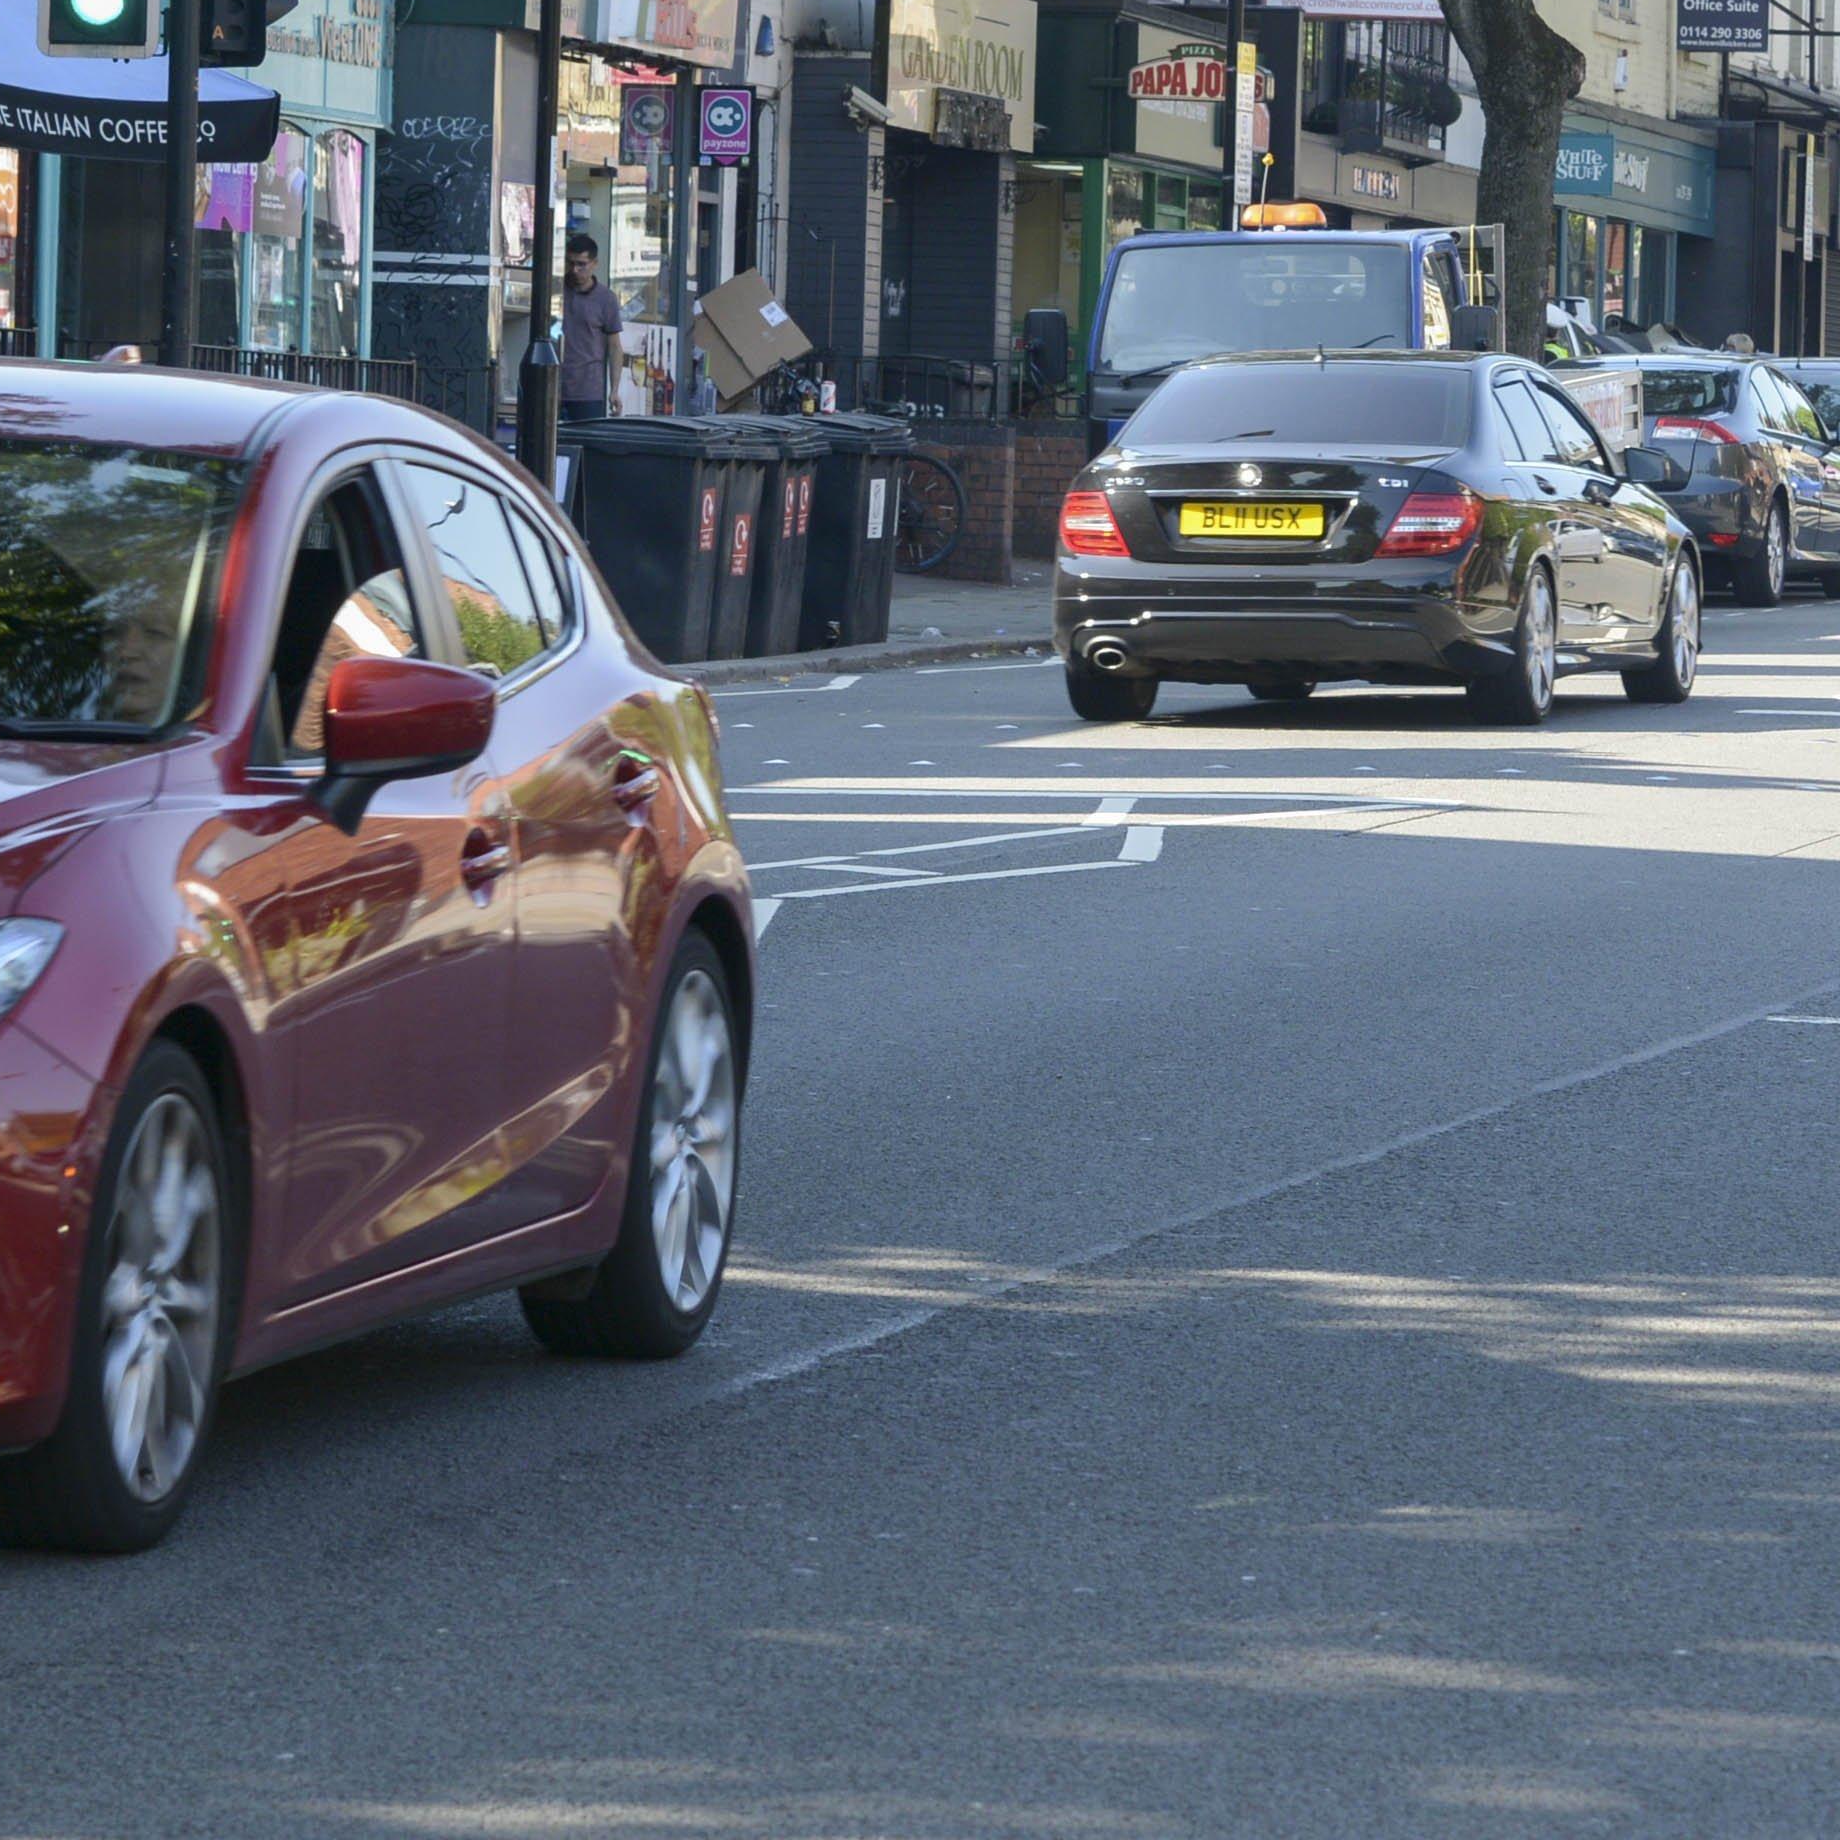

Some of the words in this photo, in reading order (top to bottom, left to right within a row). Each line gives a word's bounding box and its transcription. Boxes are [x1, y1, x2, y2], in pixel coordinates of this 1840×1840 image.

[1727, 0, 1759, 12] Suite
[212, 24, 224, 40] A
[1680, 26, 1708, 38] 0114
[1180, 45, 1216, 56] PIZZA
[974, 39, 1025, 101] ROOM
[1131, 62, 1187, 96] PAPA
[16, 107, 91, 139] ITALIAN
[98, 118, 168, 144] COFFE
[703, 137, 747, 151] payzone
[1202, 505, 1245, 529] BL11
[1253, 507, 1302, 530] USX
